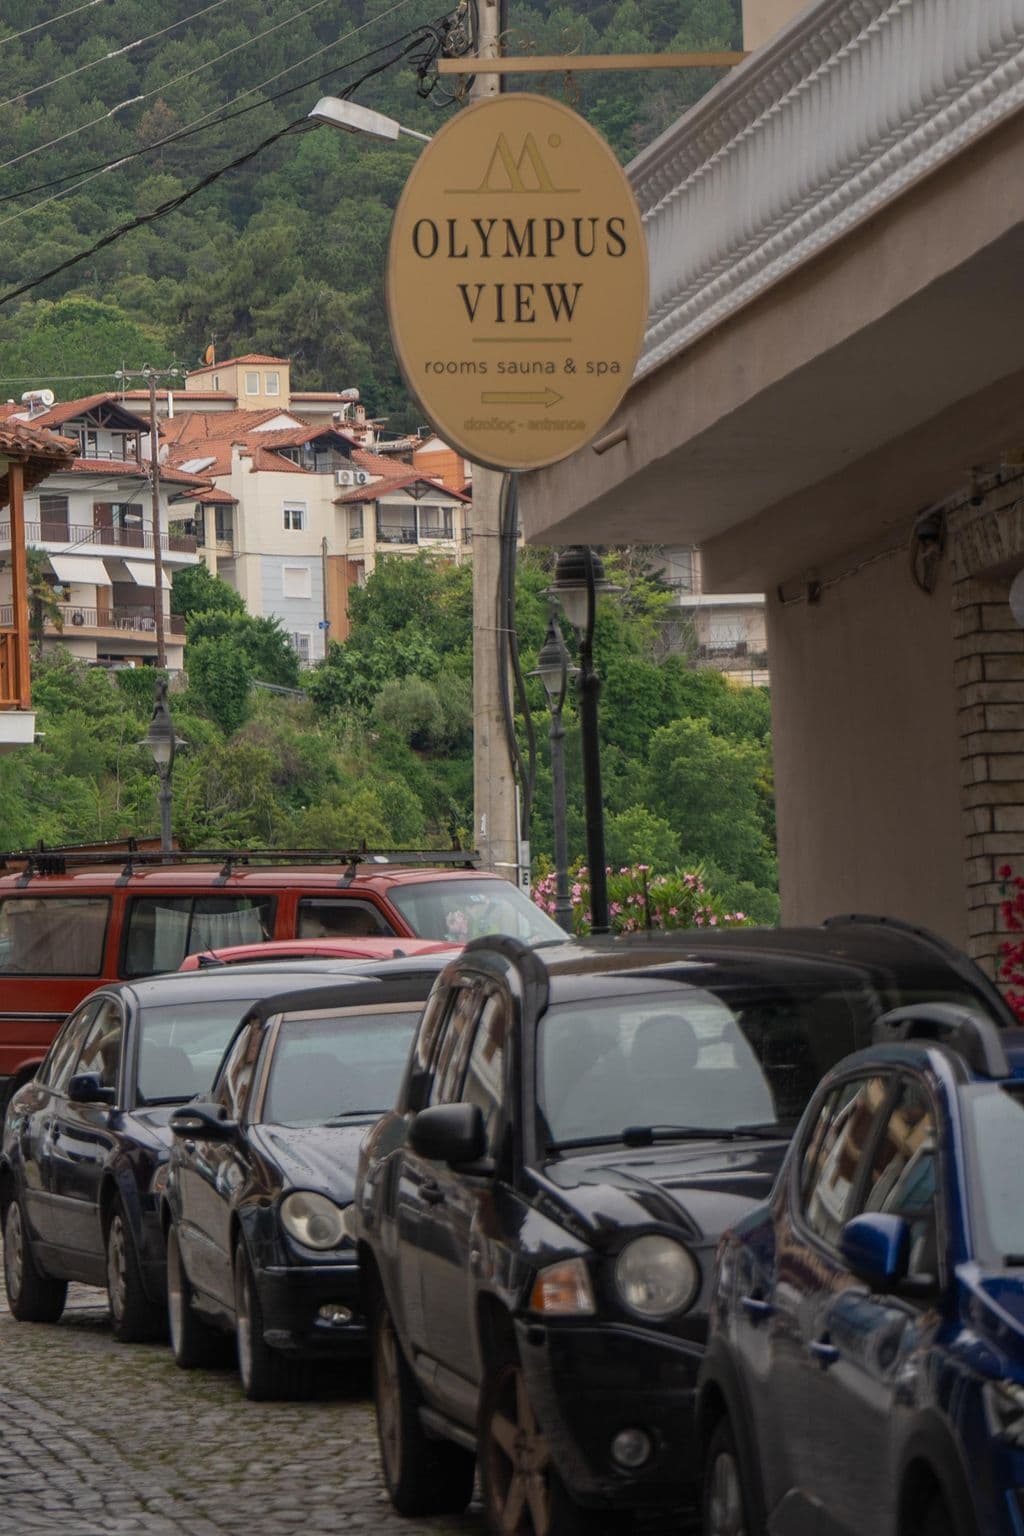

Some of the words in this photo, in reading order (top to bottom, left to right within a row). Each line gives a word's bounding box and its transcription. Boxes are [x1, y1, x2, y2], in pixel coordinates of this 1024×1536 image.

[411, 216, 628, 260] OLYMPUS
[455, 282, 584, 324] VIEW
[424, 359, 488, 375] rooms
[496, 359, 557, 375] sauna
[563, 357, 577, 375] &
[585, 359, 621, 377] spa
